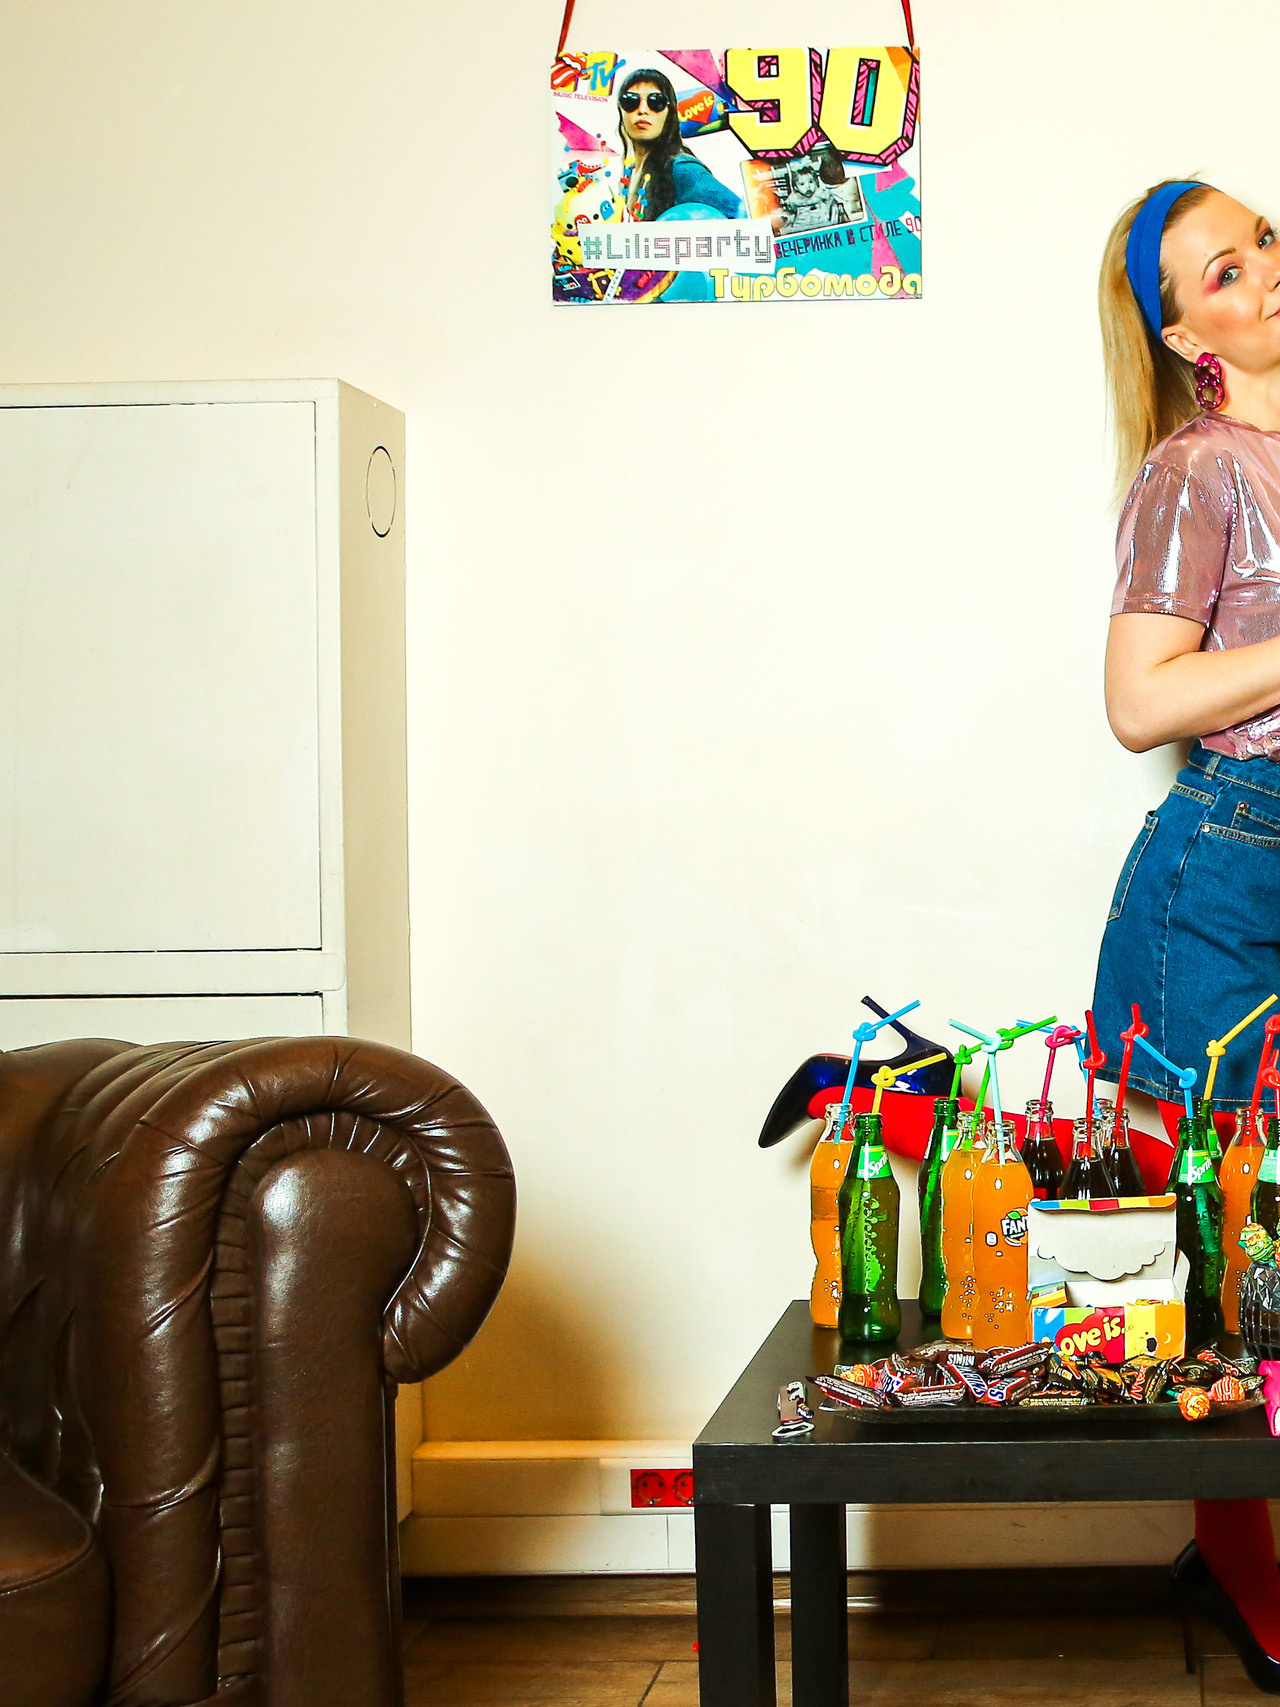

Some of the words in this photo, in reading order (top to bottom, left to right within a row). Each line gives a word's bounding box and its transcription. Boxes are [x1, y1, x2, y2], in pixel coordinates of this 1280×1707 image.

[724, 46, 918, 166] 90
[583, 229, 772, 264] #Lilisparty
[774, 229, 843, 259] ВЕЧЕРИНКА
[846, 228, 856, 245] В
[709, 266, 922, 302] Турбомода
[1001, 1216, 1028, 1236] FAN
